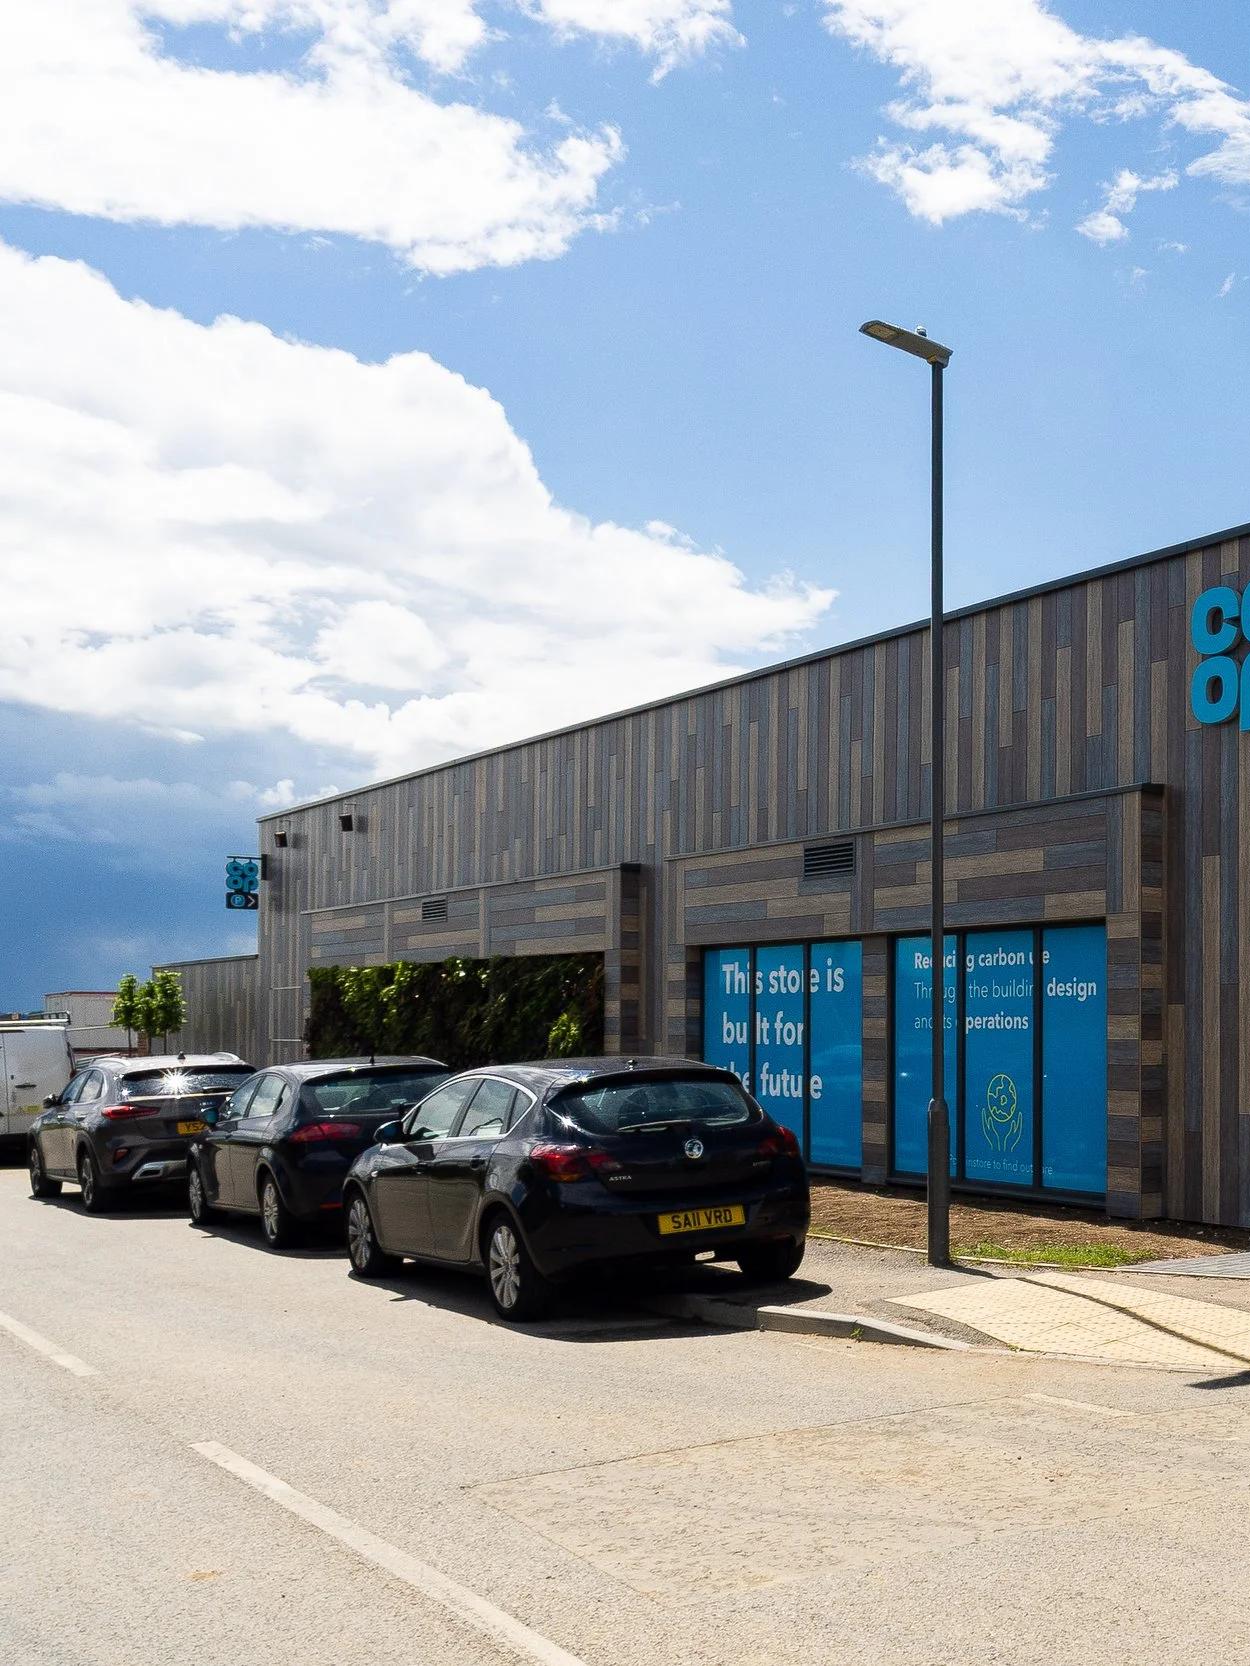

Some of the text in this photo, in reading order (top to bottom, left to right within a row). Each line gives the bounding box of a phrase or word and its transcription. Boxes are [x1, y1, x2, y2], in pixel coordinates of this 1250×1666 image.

[978, 947, 1025, 966] carbon
[768, 965, 820, 994] stoe
[827, 957, 845, 992] is
[968, 980, 988, 998] the
[992, 979, 1034, 998] buildin
[1047, 977, 1097, 1001] design
[723, 1011, 804, 1046] bult for
[943, 1013, 952, 1029] ts
[956, 1011, 1029, 1034] perations
[760, 1062, 823, 1100] futue
[993, 1159, 1001, 1170] to
[1003, 1158, 1018, 1171] find
[704, 1208, 733, 1225] VRD
